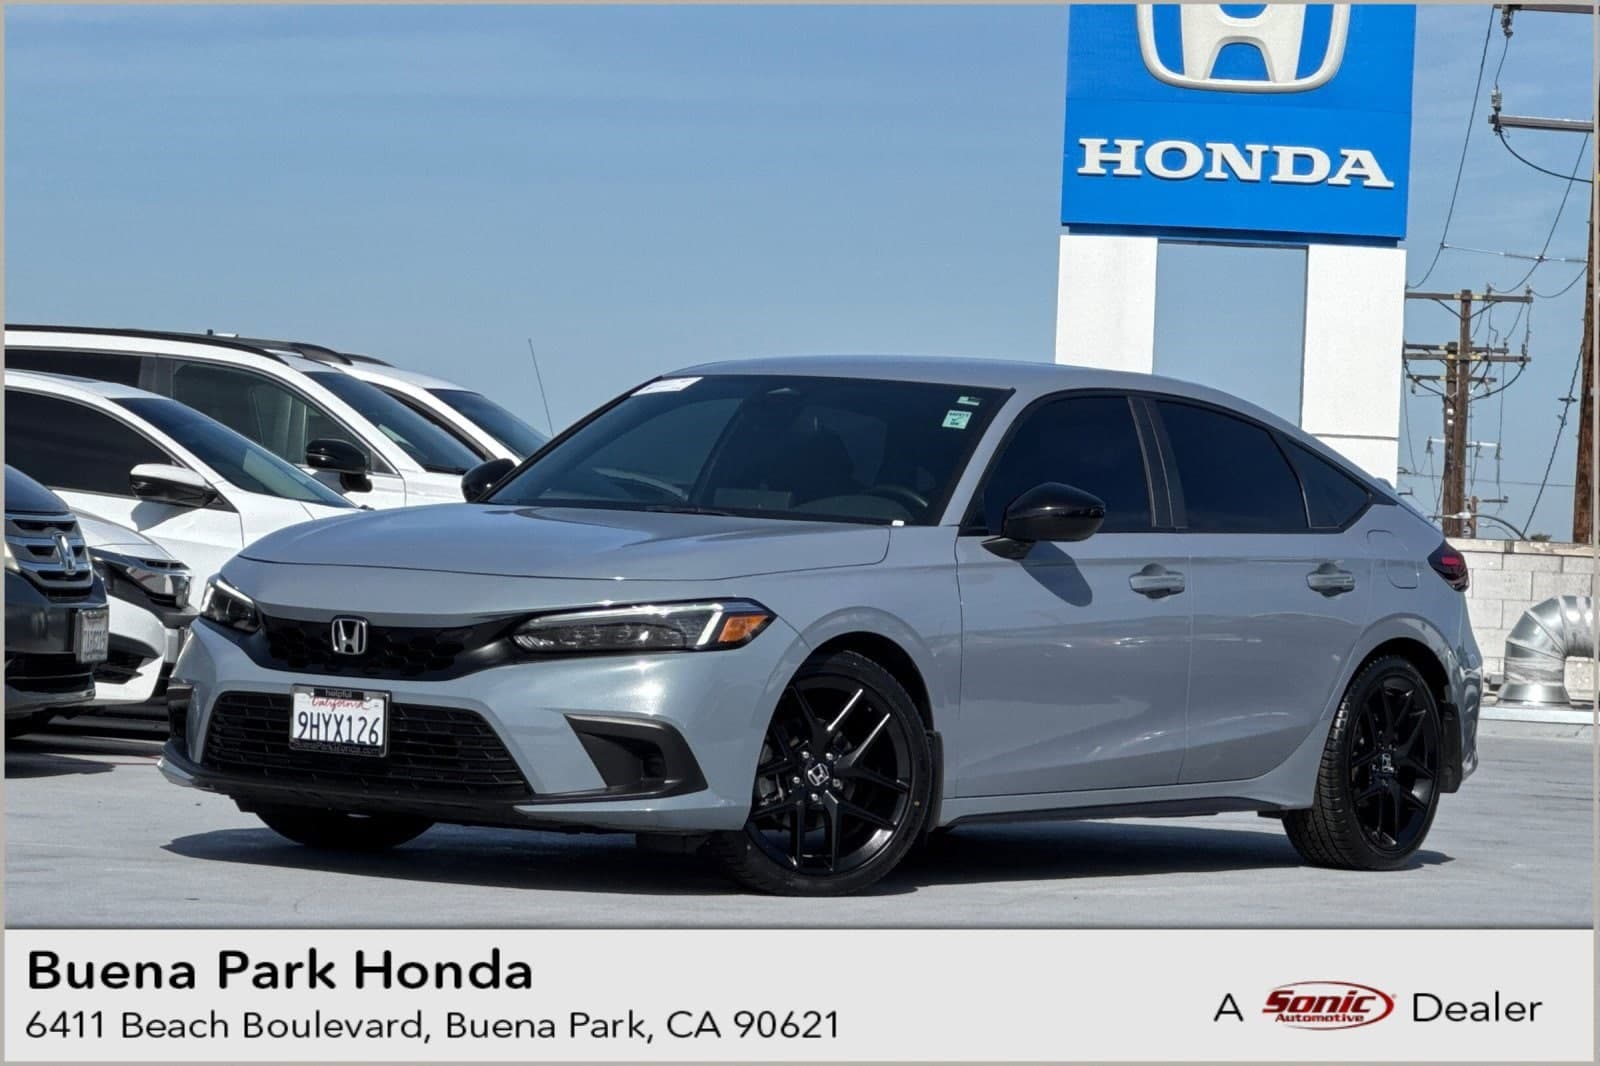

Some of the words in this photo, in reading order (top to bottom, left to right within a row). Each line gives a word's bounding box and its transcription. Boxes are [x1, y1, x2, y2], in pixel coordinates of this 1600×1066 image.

[1077, 137, 1395, 190] HONDA
[311, 696, 371, 712] California
[297, 711, 381, 746] 9HYX126
